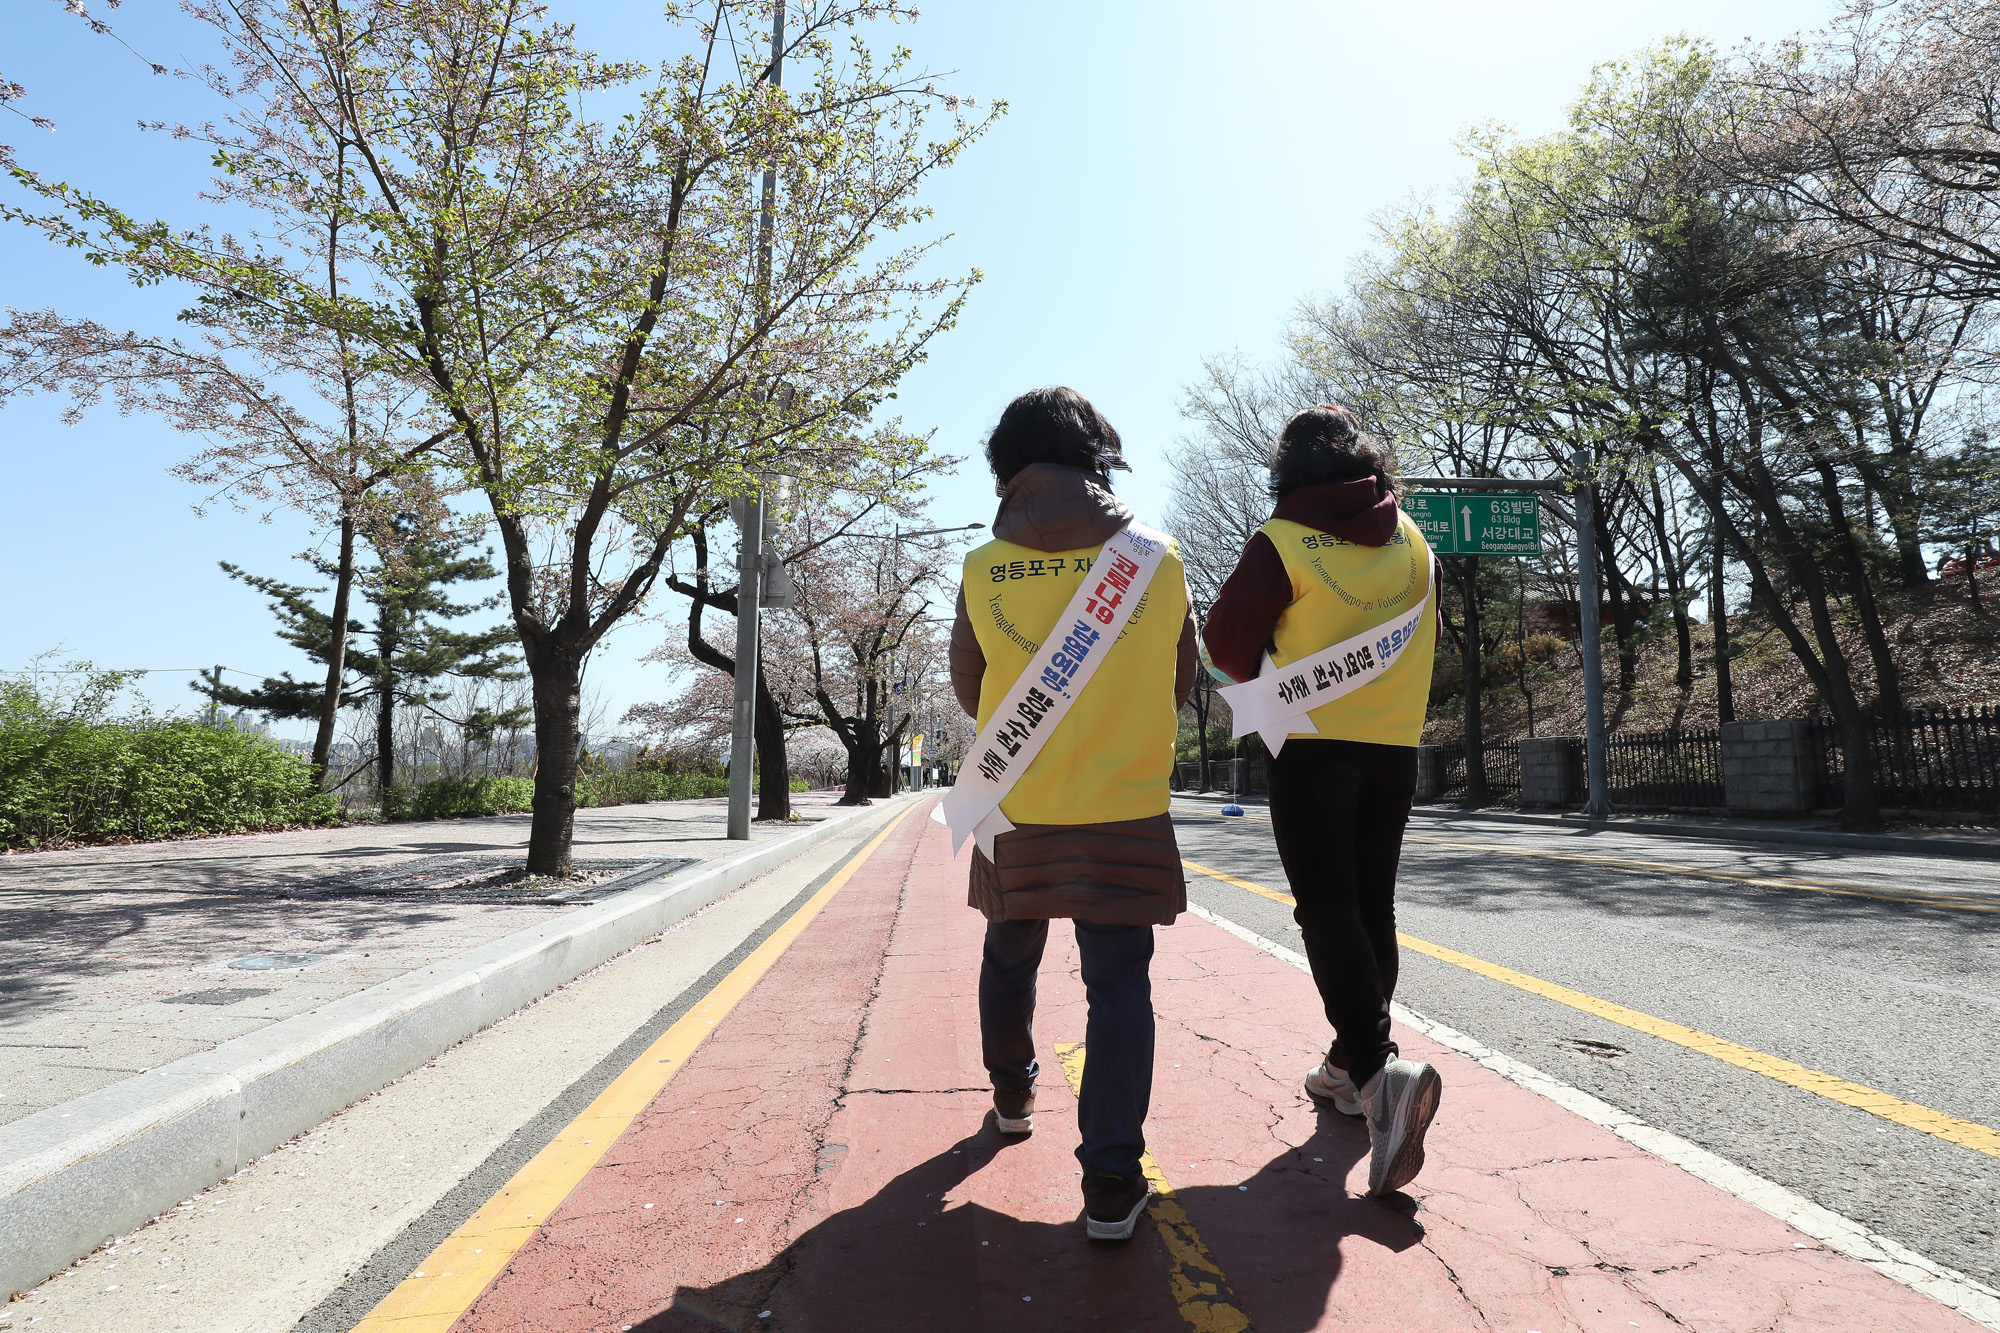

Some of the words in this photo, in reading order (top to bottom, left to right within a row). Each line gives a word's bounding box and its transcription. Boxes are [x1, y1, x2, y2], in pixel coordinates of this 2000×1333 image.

[1399, 497, 1428, 511] 항로
[1490, 500, 1534, 515] 63빌딩
[1413, 520, 1451, 533] 픽대로
[1481, 526, 1534, 540] 서강대교
[1491, 515, 1502, 523] 63
[1503, 515, 1521, 526] Bldg
[1132, 542, 1151, 558] 영등포
[990, 558, 1067, 583] 영등포구
[1311, 556, 1374, 611] Yeongdeungpo-gu
[1377, 584, 1412, 610] Volunteer
[988, 592, 1041, 655] Yeongdeungp
[1312, 644, 1375, 692] 방역수칙
[1277, 673, 1311, 705] 준수
[995, 686, 1055, 757] 방역수칙
[976, 750, 1009, 784] 준수
